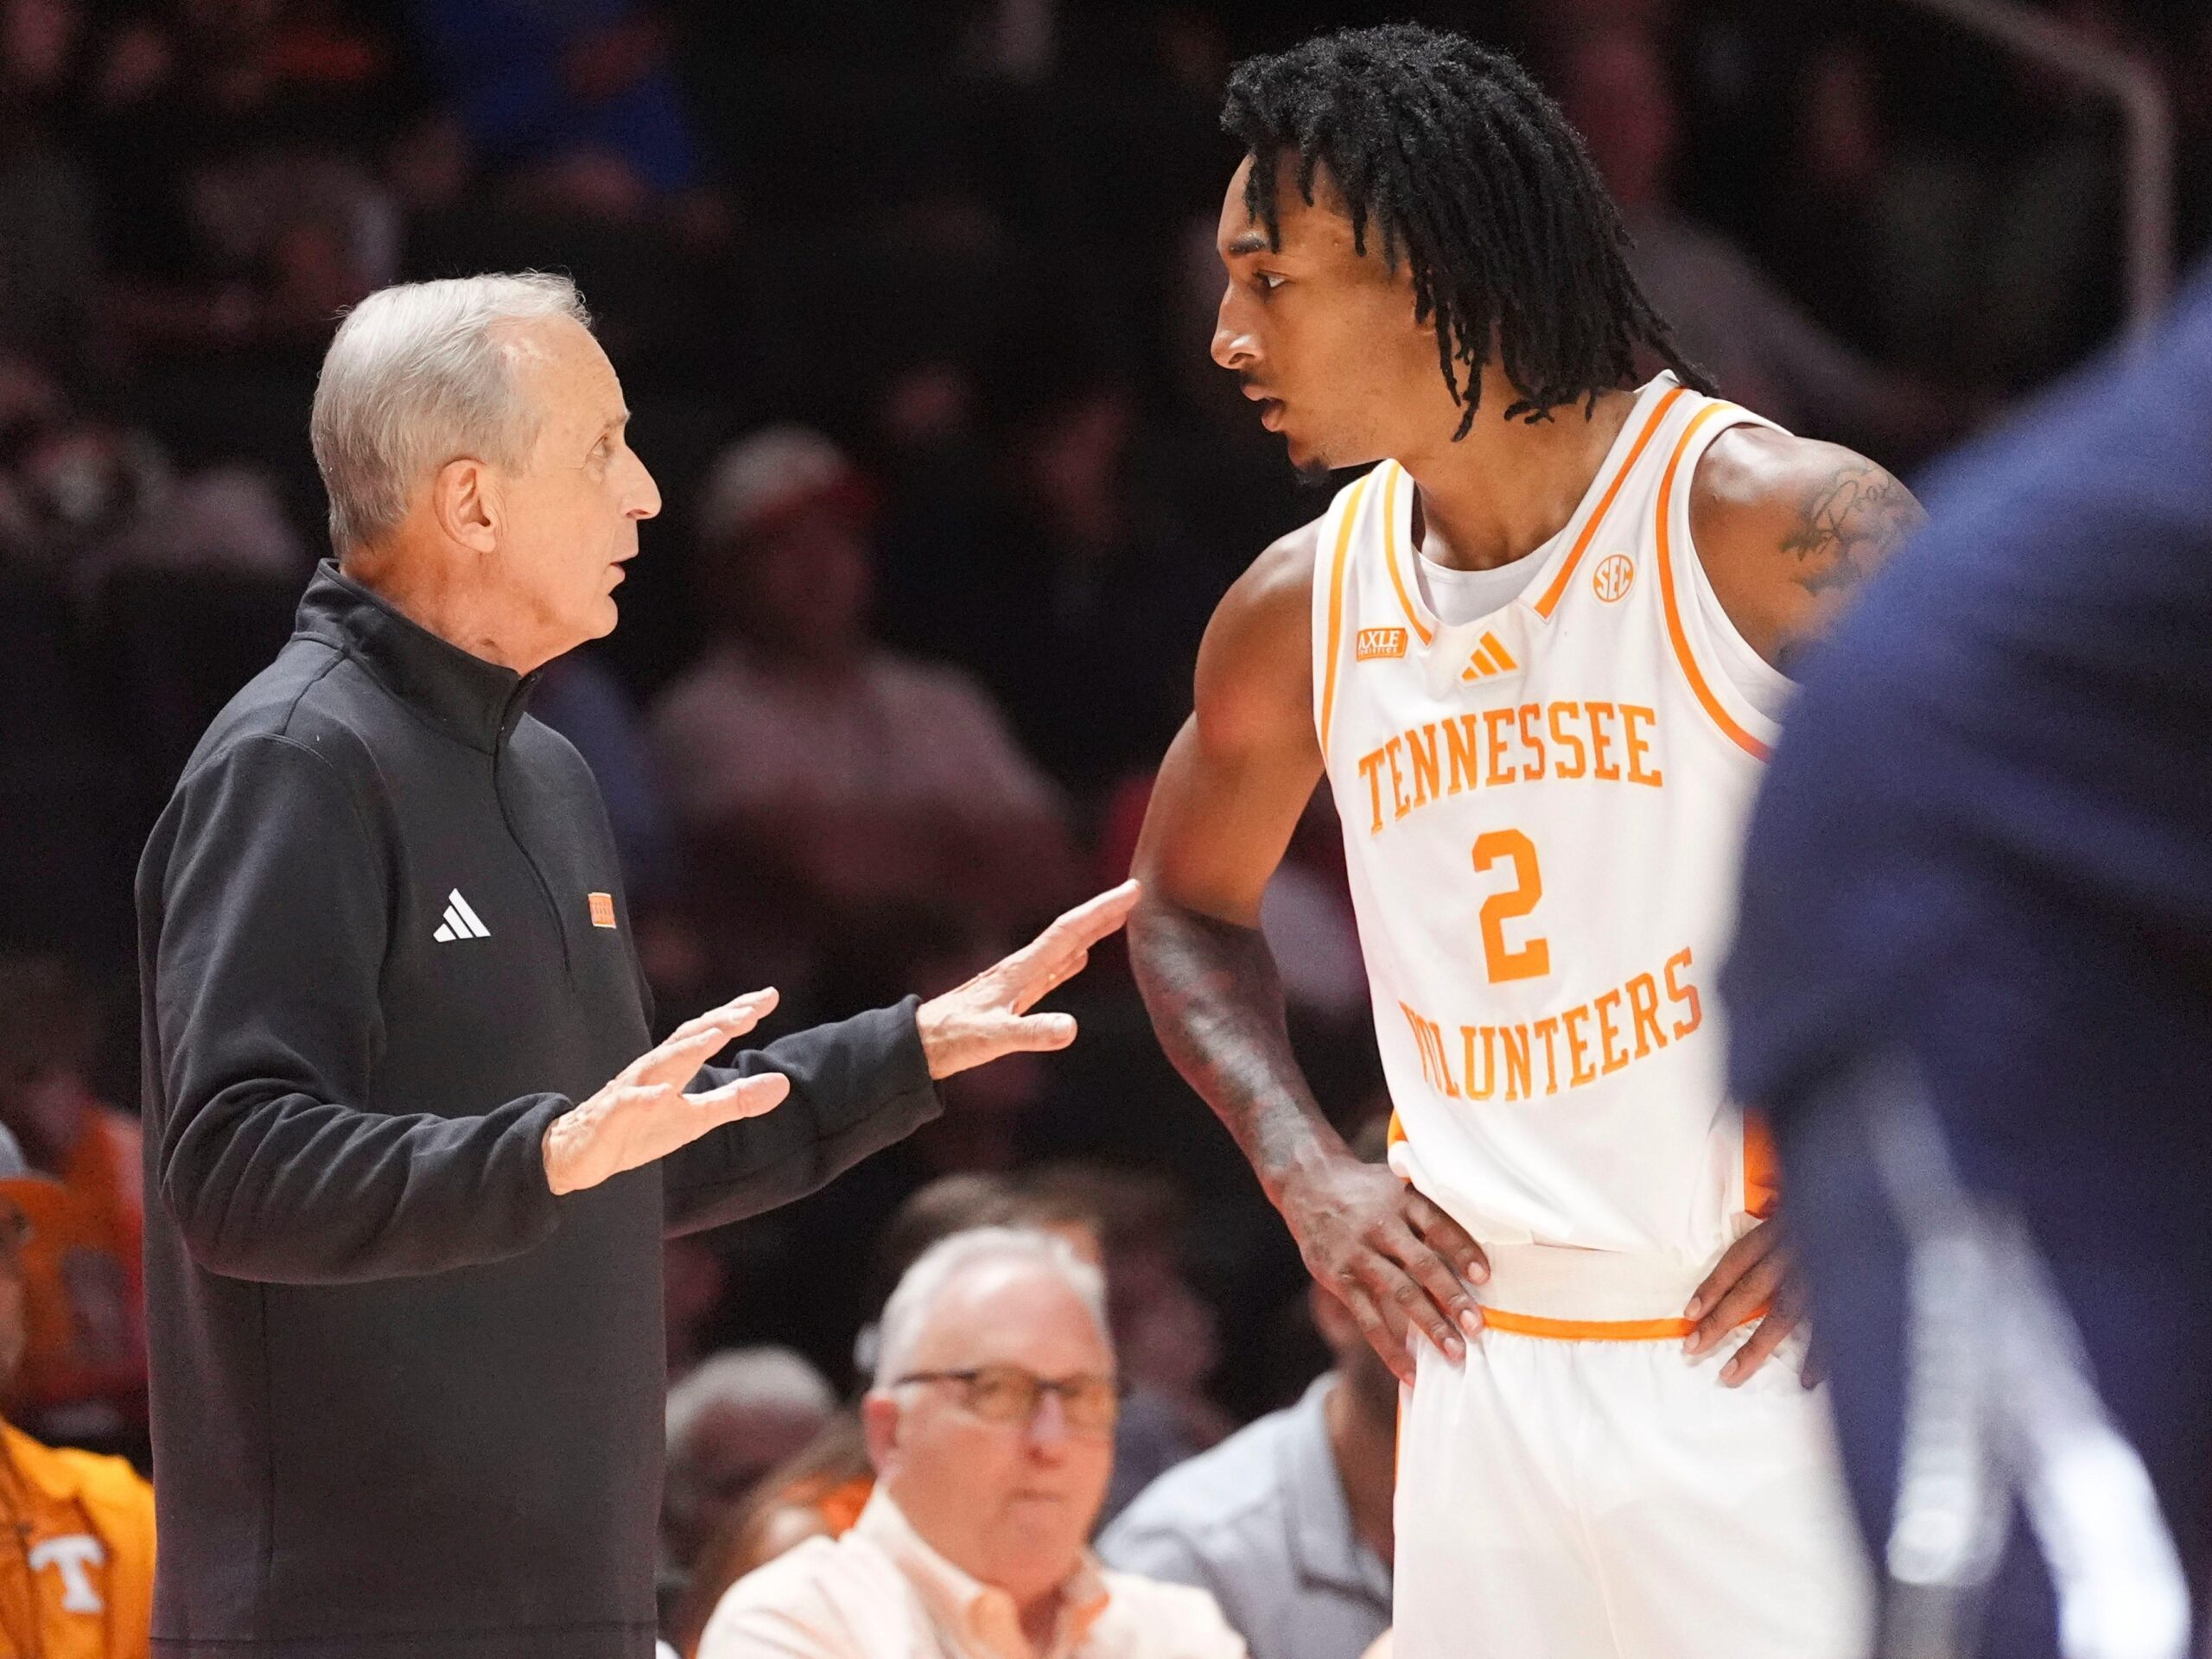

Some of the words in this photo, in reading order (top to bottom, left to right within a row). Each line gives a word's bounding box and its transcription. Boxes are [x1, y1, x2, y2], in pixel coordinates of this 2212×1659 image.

[1593, 556, 1632, 601] SEC
[1357, 630, 1400, 650] AXLE
[1358, 701, 1662, 835] TENNESSEE
[1471, 829, 1550, 984] 2
[29, 1535, 104, 1611] T
